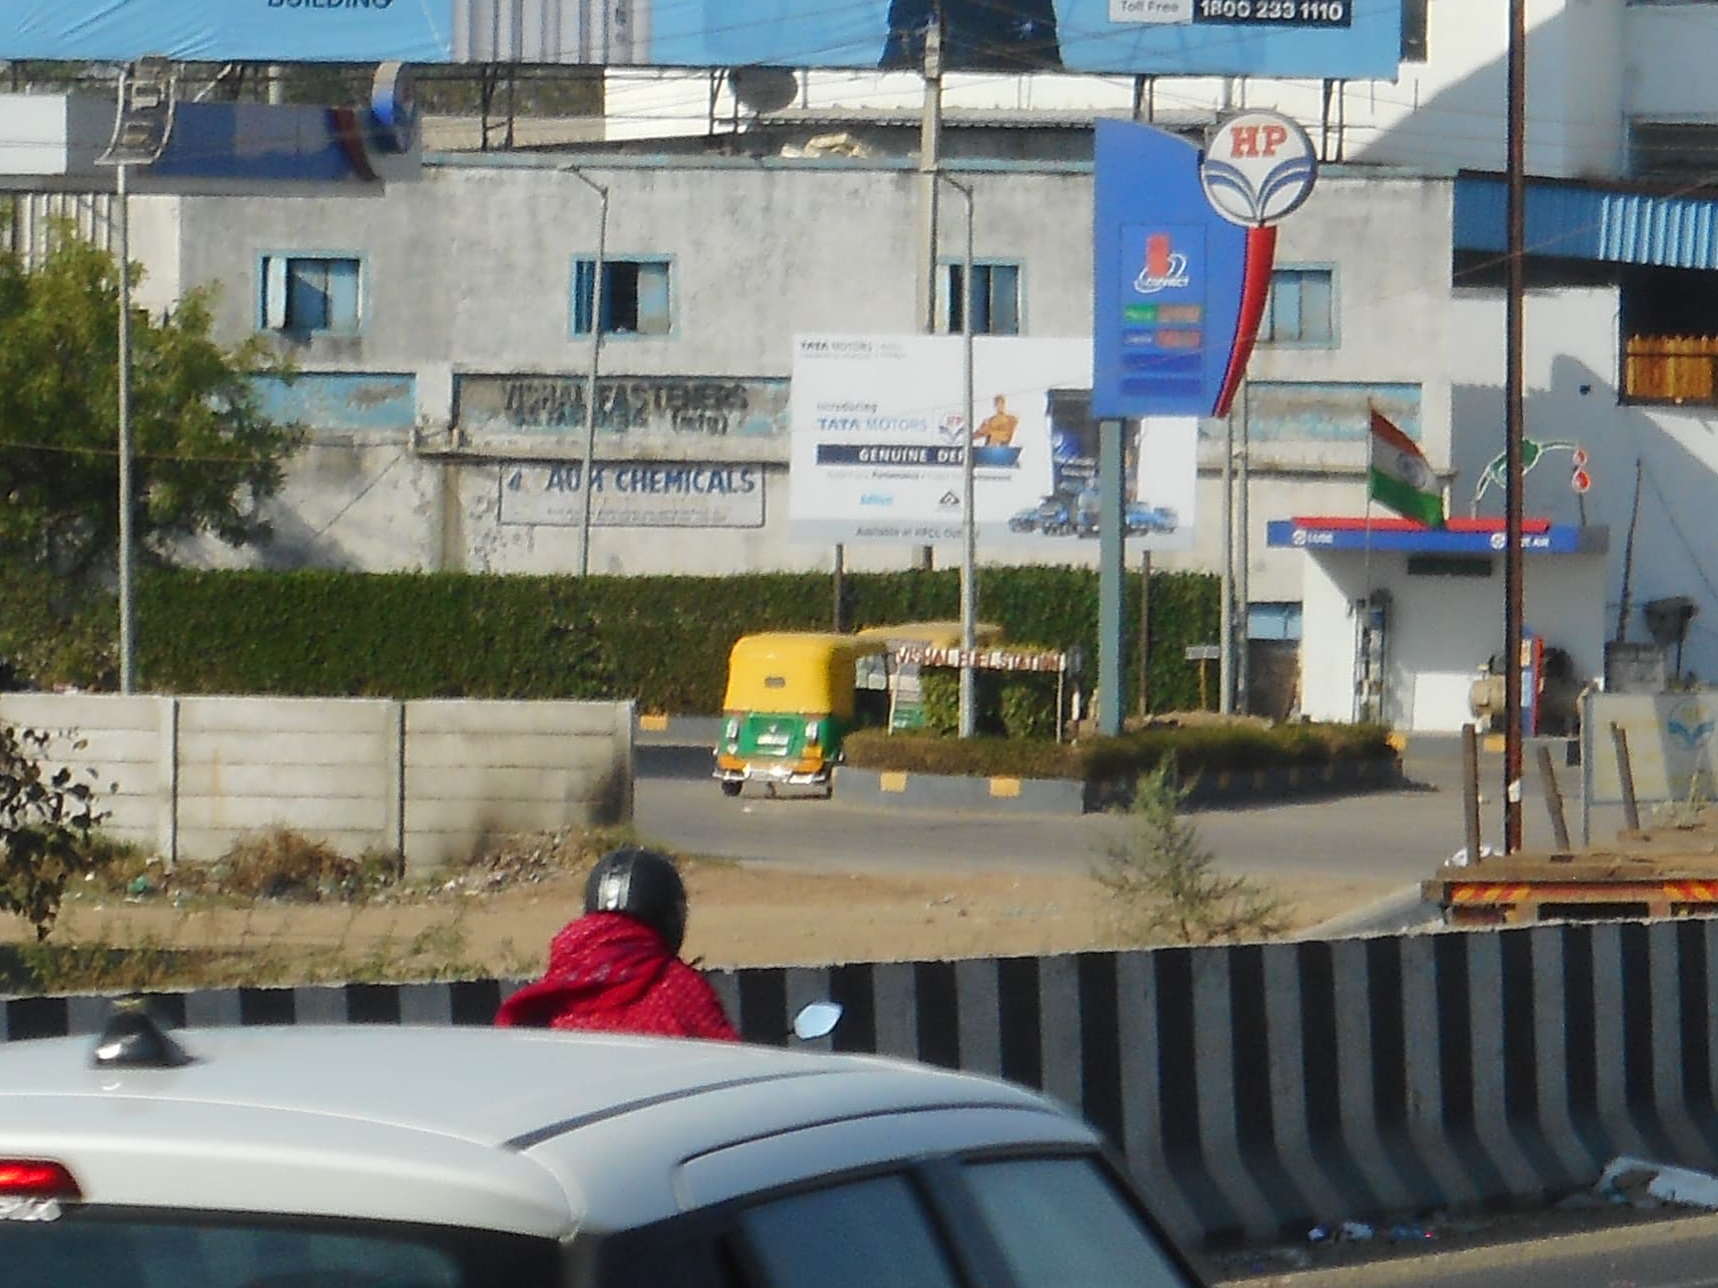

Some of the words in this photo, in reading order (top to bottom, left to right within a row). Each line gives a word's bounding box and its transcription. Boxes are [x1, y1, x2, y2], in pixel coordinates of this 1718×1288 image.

[1120, 0, 1140, 13] Toll
[1148, 0, 1179, 13] Free
[1256, 0, 1295, 20] 233
[1299, 1, 1343, 22] 1110
[1230, 124, 1288, 159] HP
[817, 418, 860, 431] TATA
[865, 418, 928, 431] MOTORS
[858, 447, 928, 463] GENUINE
[616, 466, 756, 495] CHEMICALS
